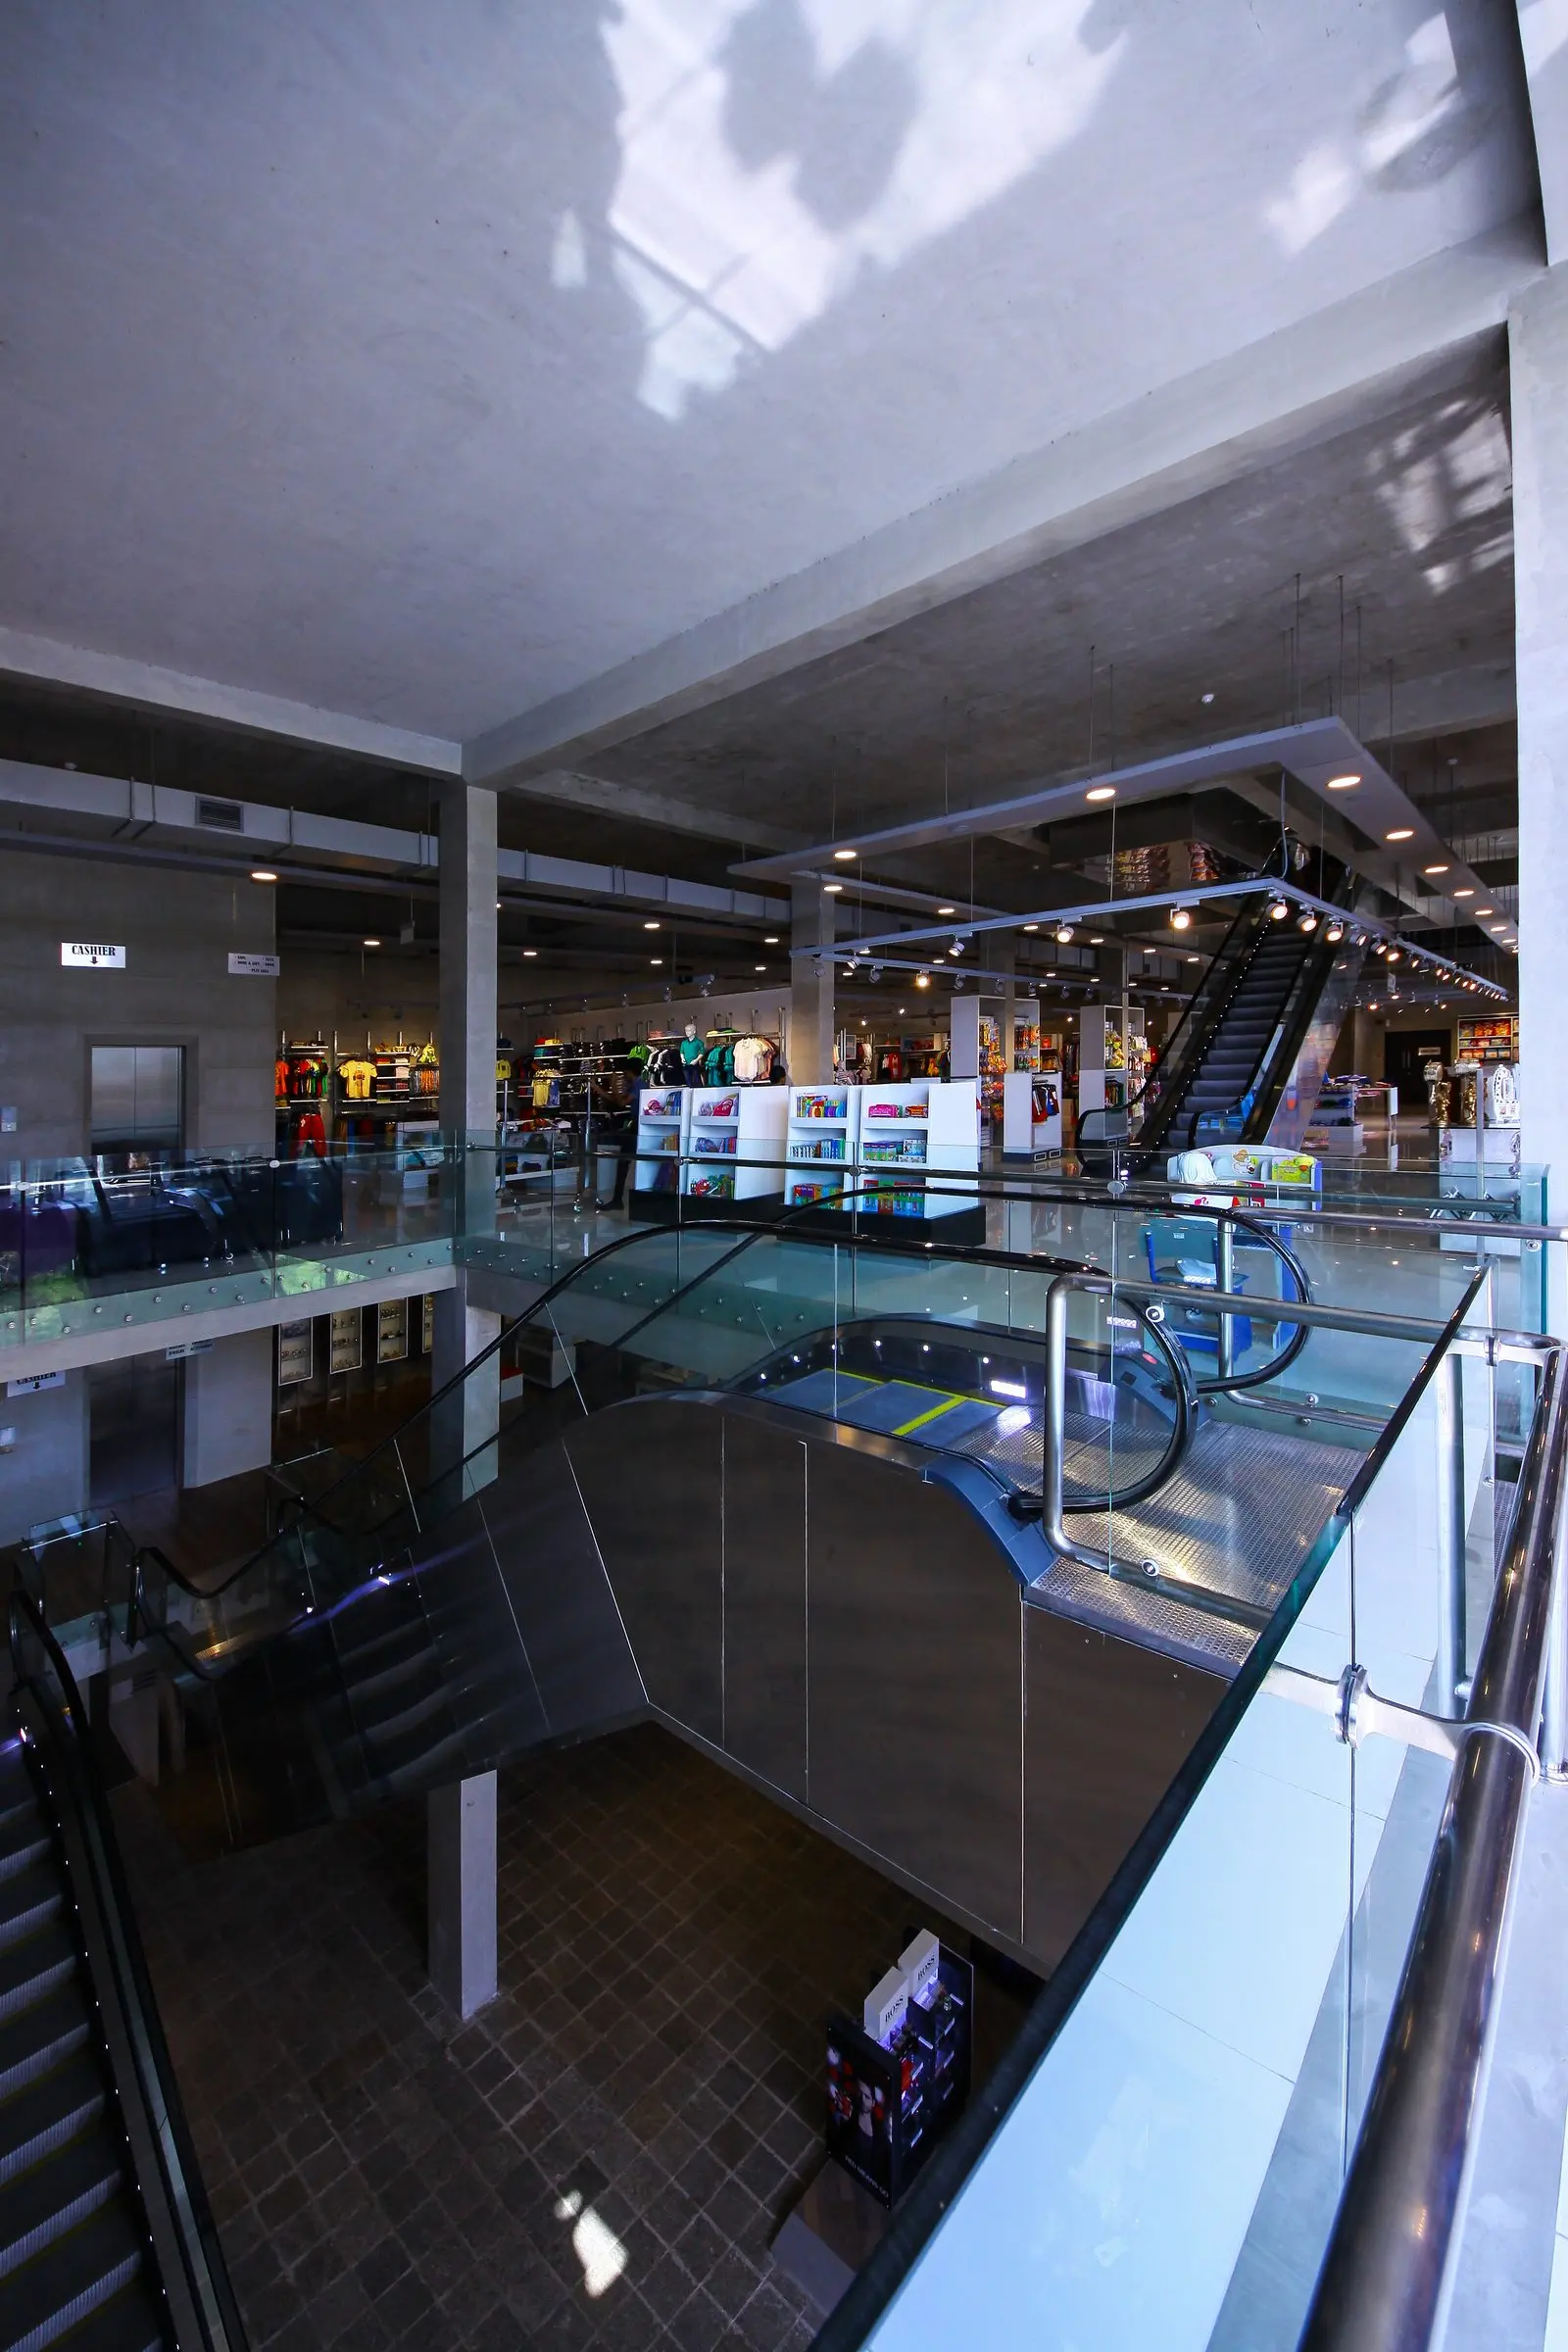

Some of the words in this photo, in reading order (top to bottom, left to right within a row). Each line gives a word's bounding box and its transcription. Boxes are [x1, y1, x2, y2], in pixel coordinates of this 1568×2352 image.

[72, 945, 117, 956] CASHIER
[917, 1954, 935, 1981] BOSS
[885, 1994, 904, 2022] BOSS
